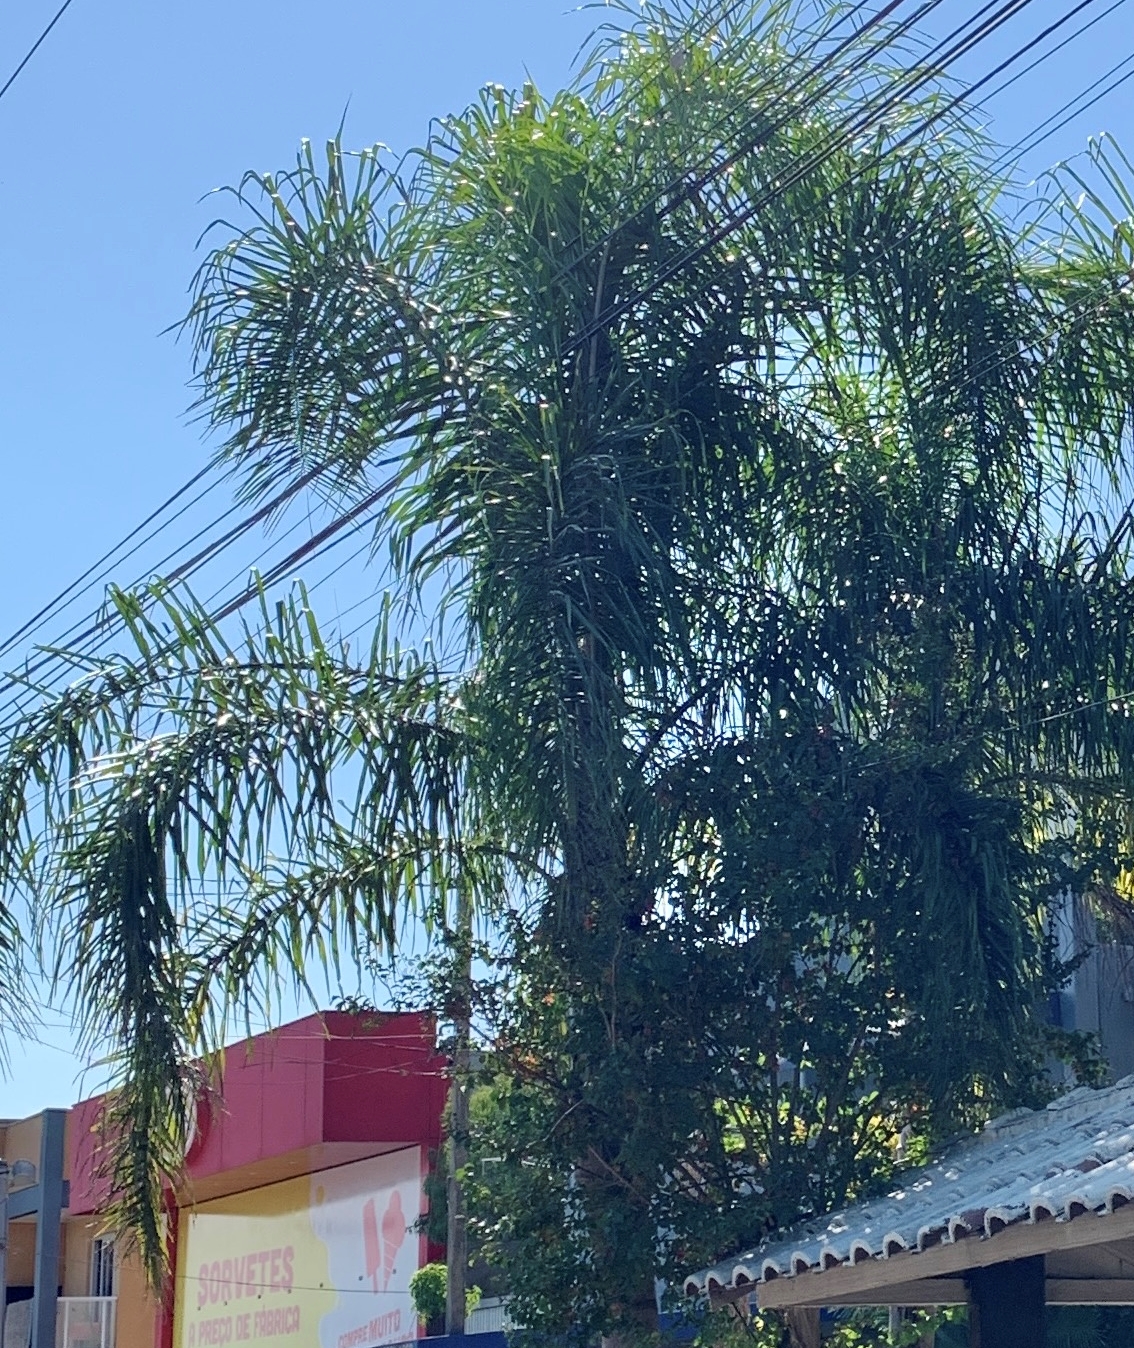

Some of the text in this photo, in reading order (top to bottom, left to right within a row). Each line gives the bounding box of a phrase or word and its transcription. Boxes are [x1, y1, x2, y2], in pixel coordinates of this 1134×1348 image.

[197, 1246, 293, 1307] SORVETES
[188, 1304, 300, 1348] A PREÇO DE FÁBRICA
[369, 1308, 401, 1342] MUITO
